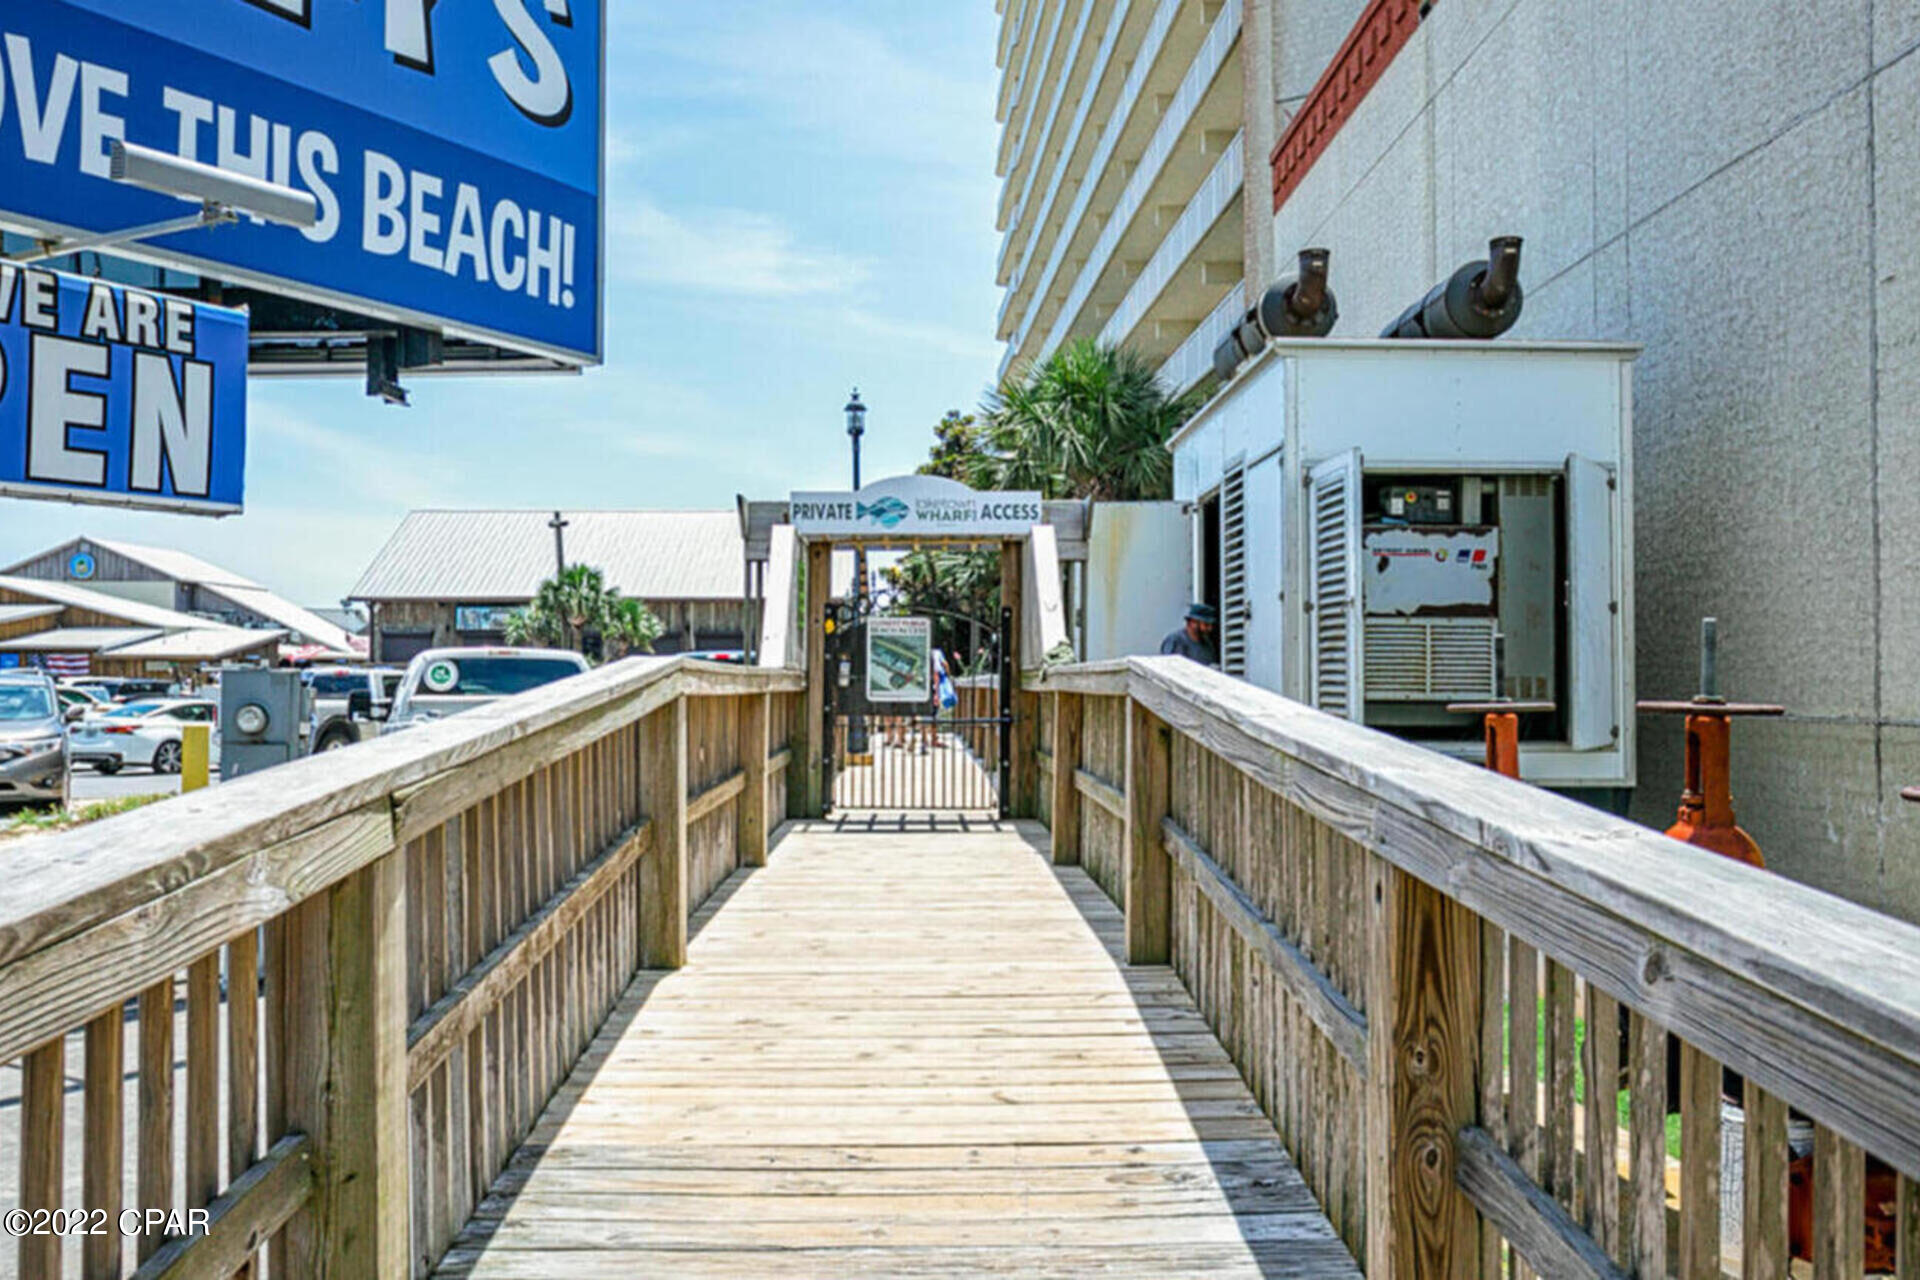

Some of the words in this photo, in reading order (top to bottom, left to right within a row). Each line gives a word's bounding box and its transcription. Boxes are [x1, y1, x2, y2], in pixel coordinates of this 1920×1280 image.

[0, 32, 129, 182] VE
[163, 85, 340, 243] THIS
[362, 149, 576, 310] BEACH!
[82, 283, 195, 356] ARE
[0, 331, 214, 497] EN
[793, 503, 852, 520] PRIVATE
[980, 504, 1039, 521] ACCESS
